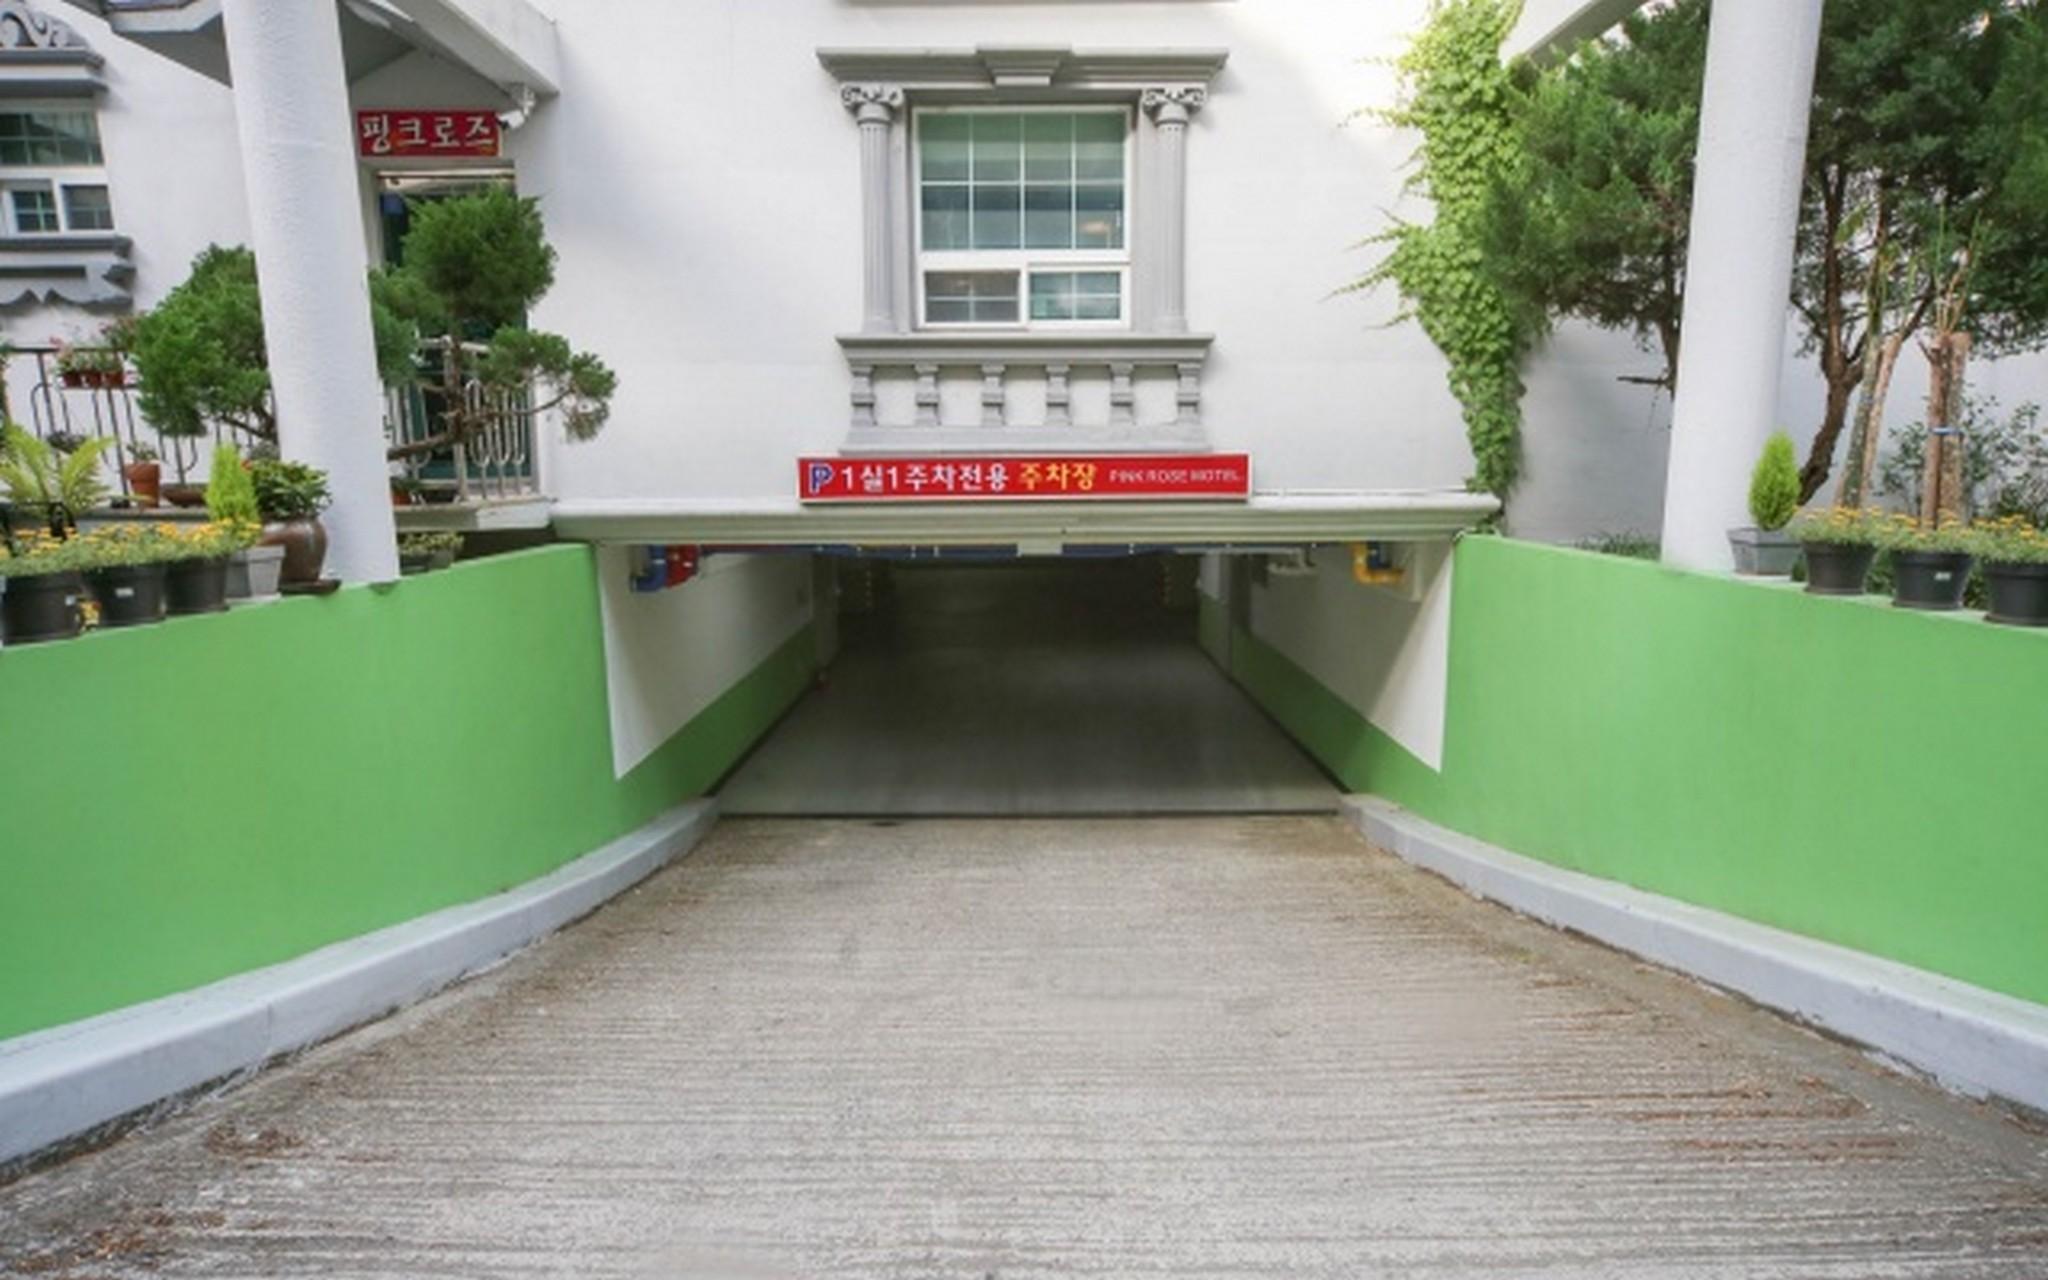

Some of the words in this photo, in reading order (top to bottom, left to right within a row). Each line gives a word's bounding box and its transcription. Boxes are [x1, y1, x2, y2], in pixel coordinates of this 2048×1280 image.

[362, 114, 494, 153] 핑크로즈
[1020, 463, 1097, 491] 주차장
[1109, 469, 1143, 483] PINK
[1145, 469, 1188, 484] ROSE
